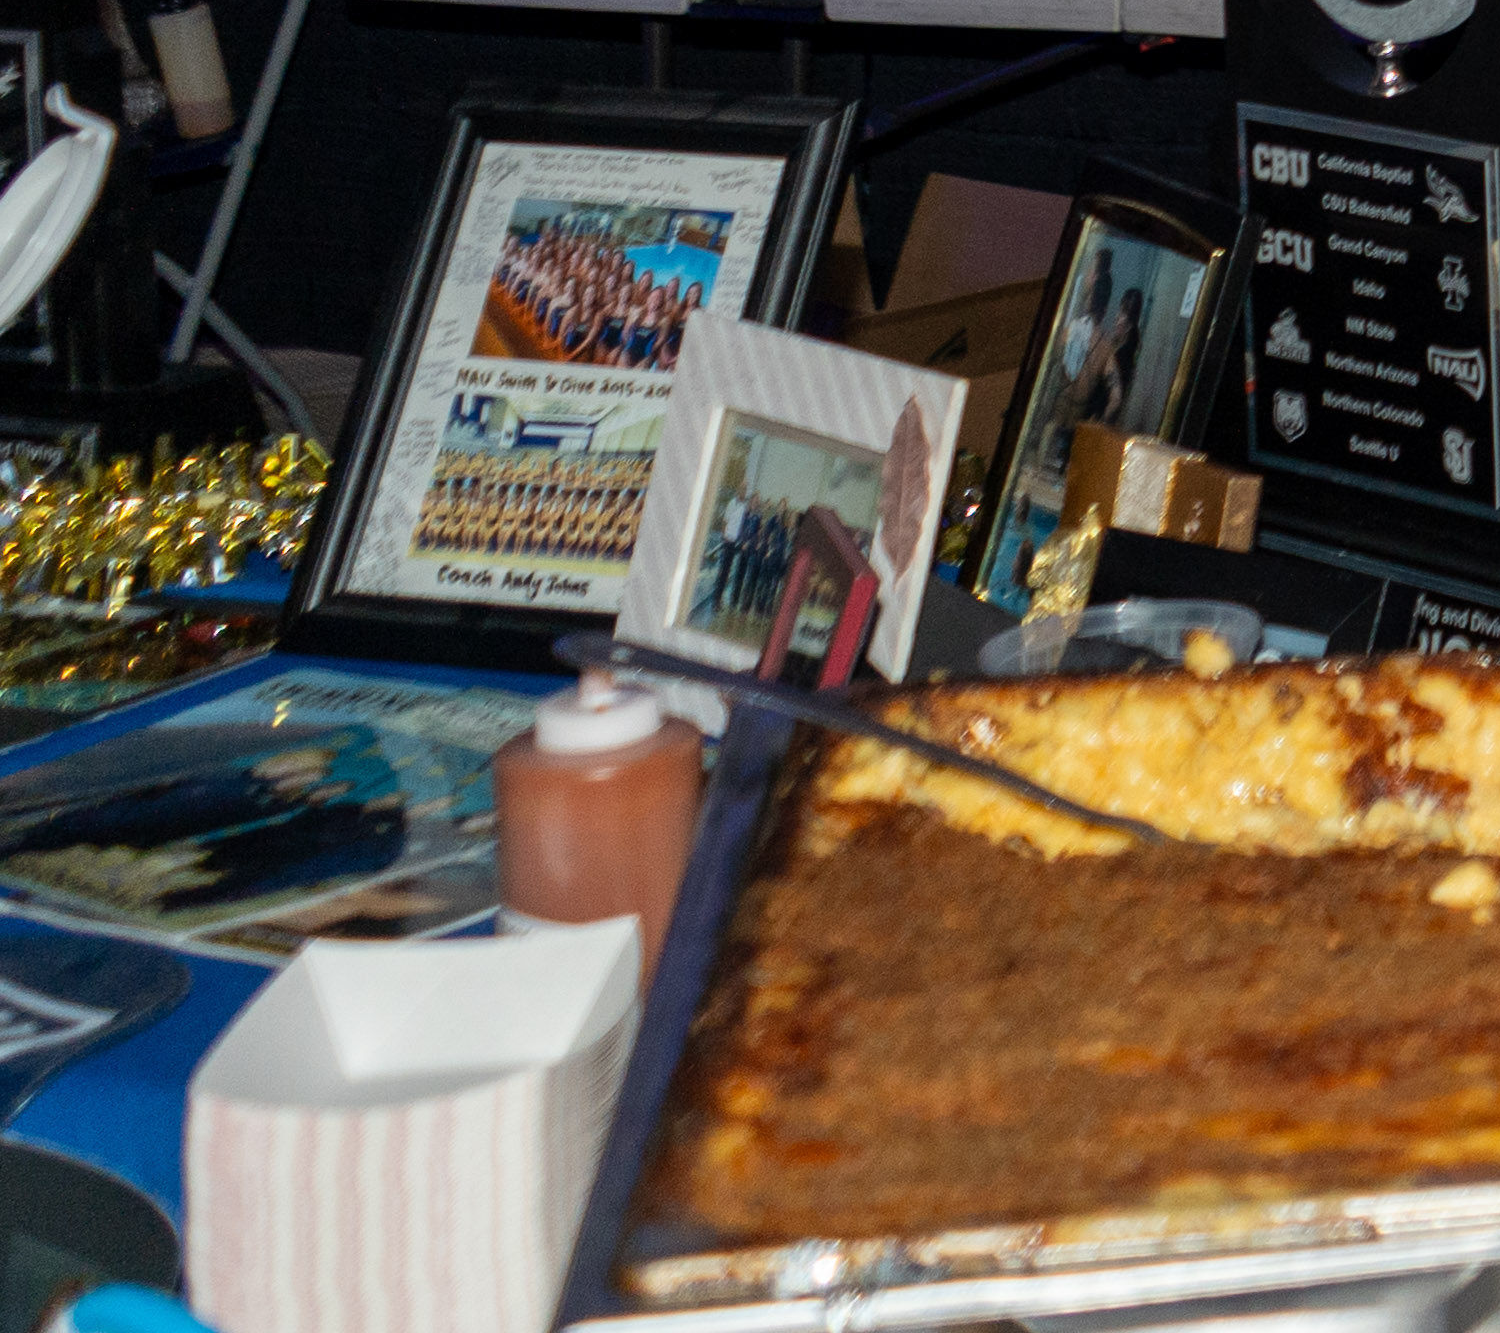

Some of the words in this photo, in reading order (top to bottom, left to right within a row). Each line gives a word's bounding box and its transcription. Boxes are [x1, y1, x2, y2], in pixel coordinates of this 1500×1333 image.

[1251, 142, 1312, 189] CBU
[1316, 151, 1372, 179] California
[1371, 161, 1415, 187] Baptist
[1347, 197, 1413, 226] Bakersfield
[1327, 232, 1363, 257] Grand
[1363, 241, 1410, 267] Canyon
[1323, 350, 1376, 378] Northern
[1375, 363, 1421, 389] Arizona
[1434, 355, 1478, 381] NAU
[1321, 389, 1373, 417] Northern
[1371, 401, 1427, 430] Colorado
[1348, 433, 1386, 458] Seattle
[1388, 441, 1401, 463] U
[437, 563, 493, 588] Coach
[1442, 605, 1471, 630] and
